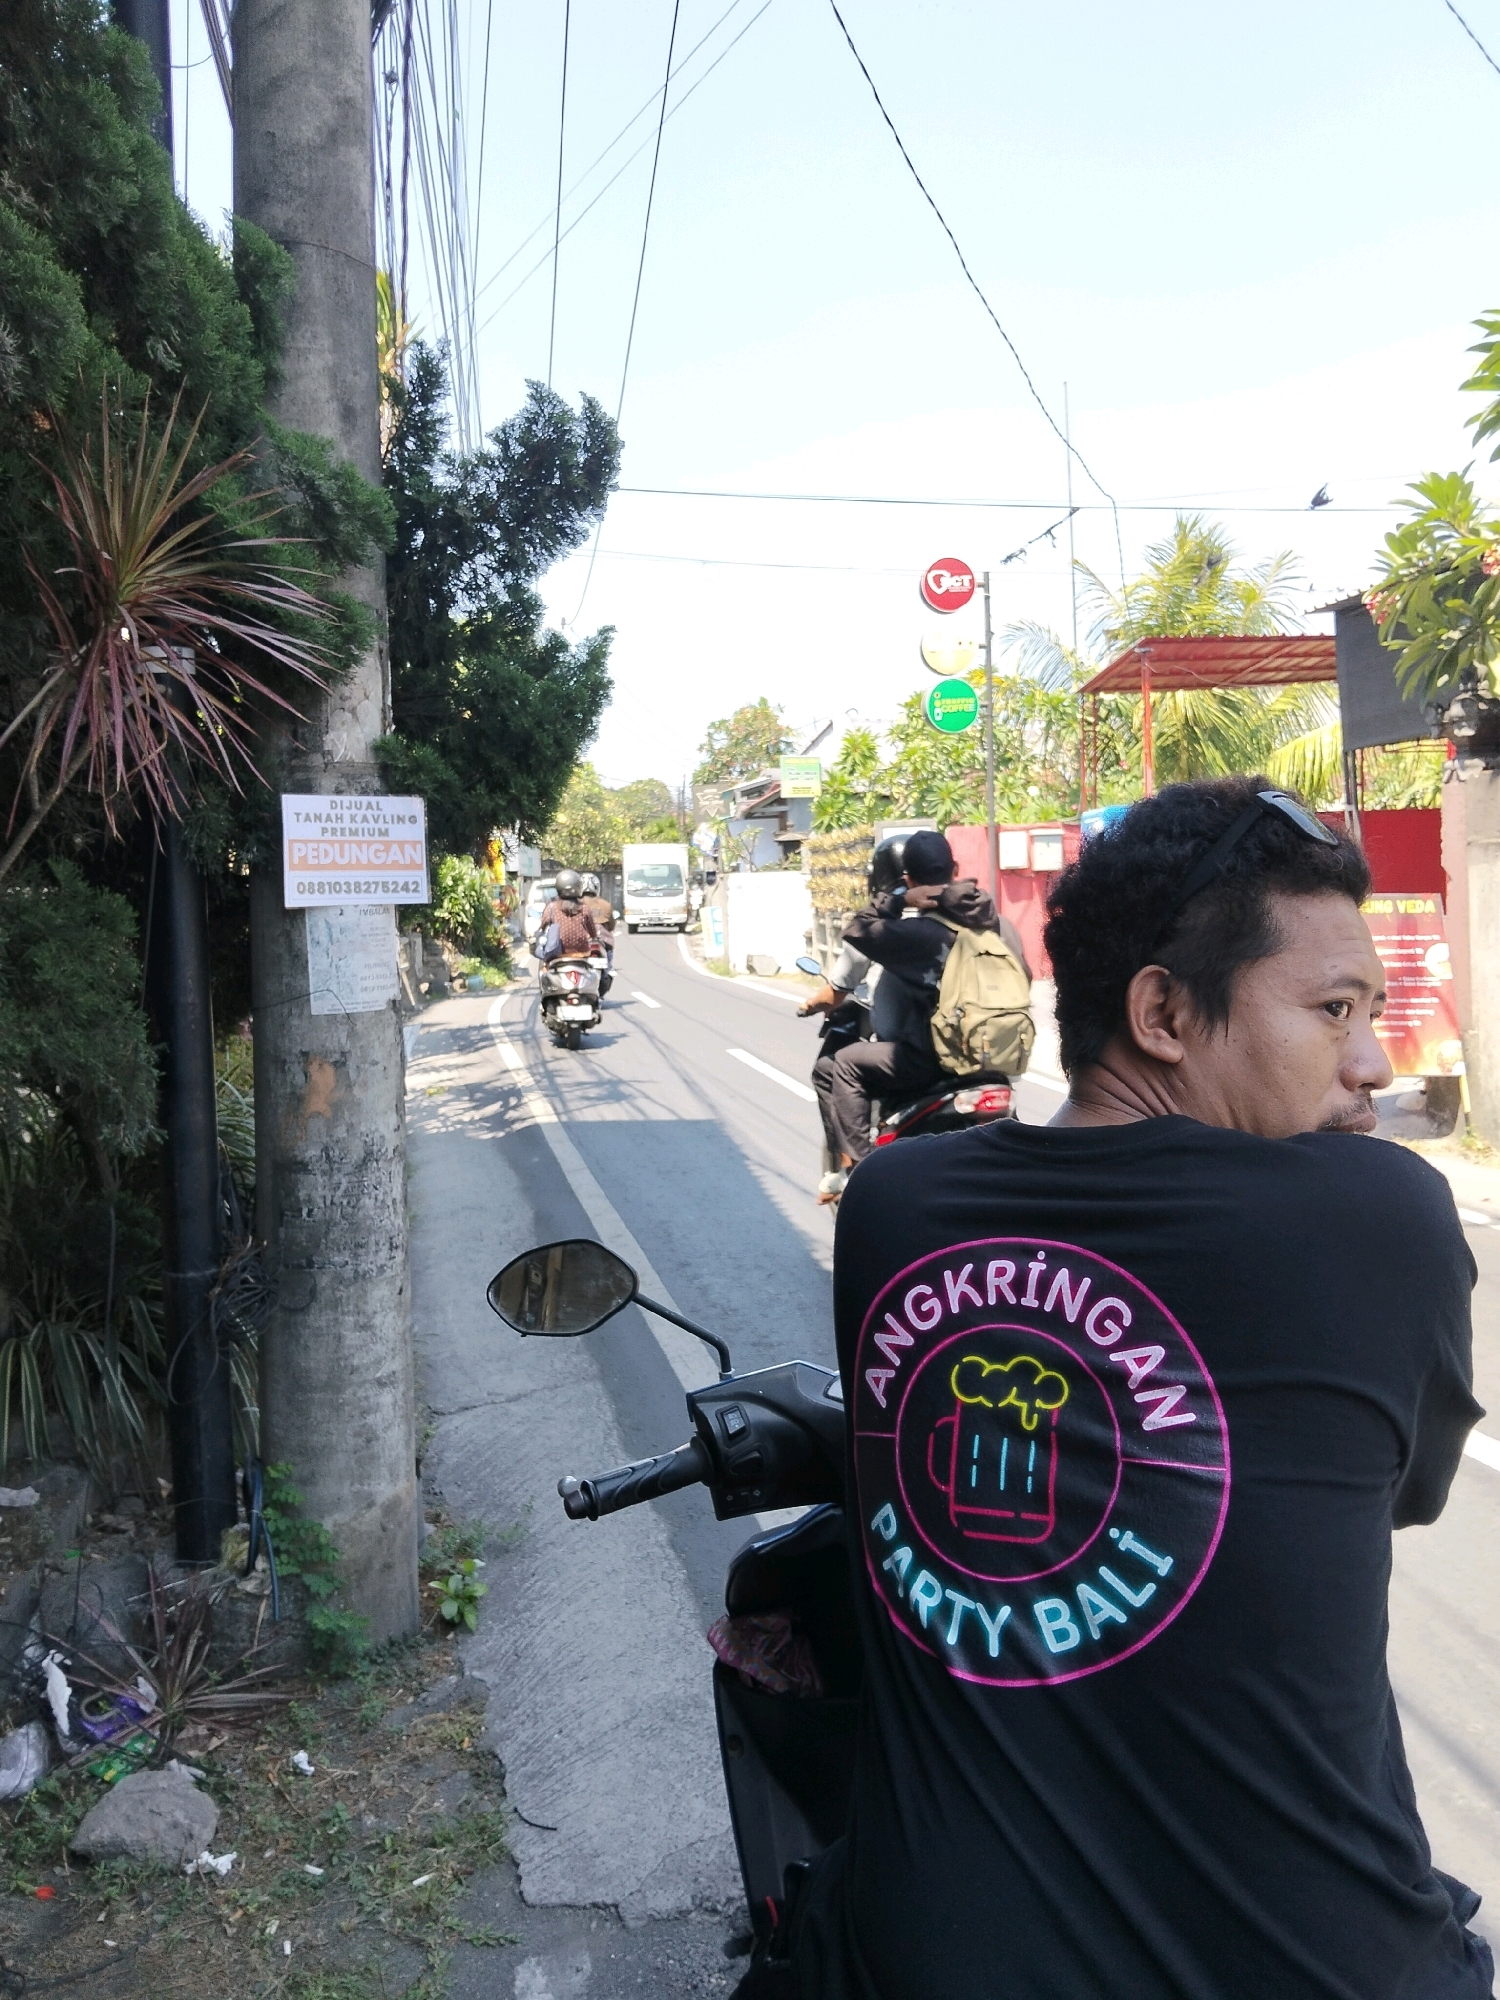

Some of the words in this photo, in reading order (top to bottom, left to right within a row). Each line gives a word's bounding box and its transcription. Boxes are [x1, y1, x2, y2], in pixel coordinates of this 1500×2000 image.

[329, 800, 383, 811] DIJUAL
[294, 812, 344, 824] TANAH
[349, 813, 418, 825] KAVLING
[321, 827, 390, 838] PREMIUM
[292, 842, 422, 865] PEDUNGAN
[296, 880, 420, 895] 0881038275242
[1396, 899, 1436, 914] VEDA
[865, 1250, 1197, 1432] ANGKRINGAN
[871, 1502, 1011, 1659] PARTY
[1033, 1527, 1174, 1654] BALI
